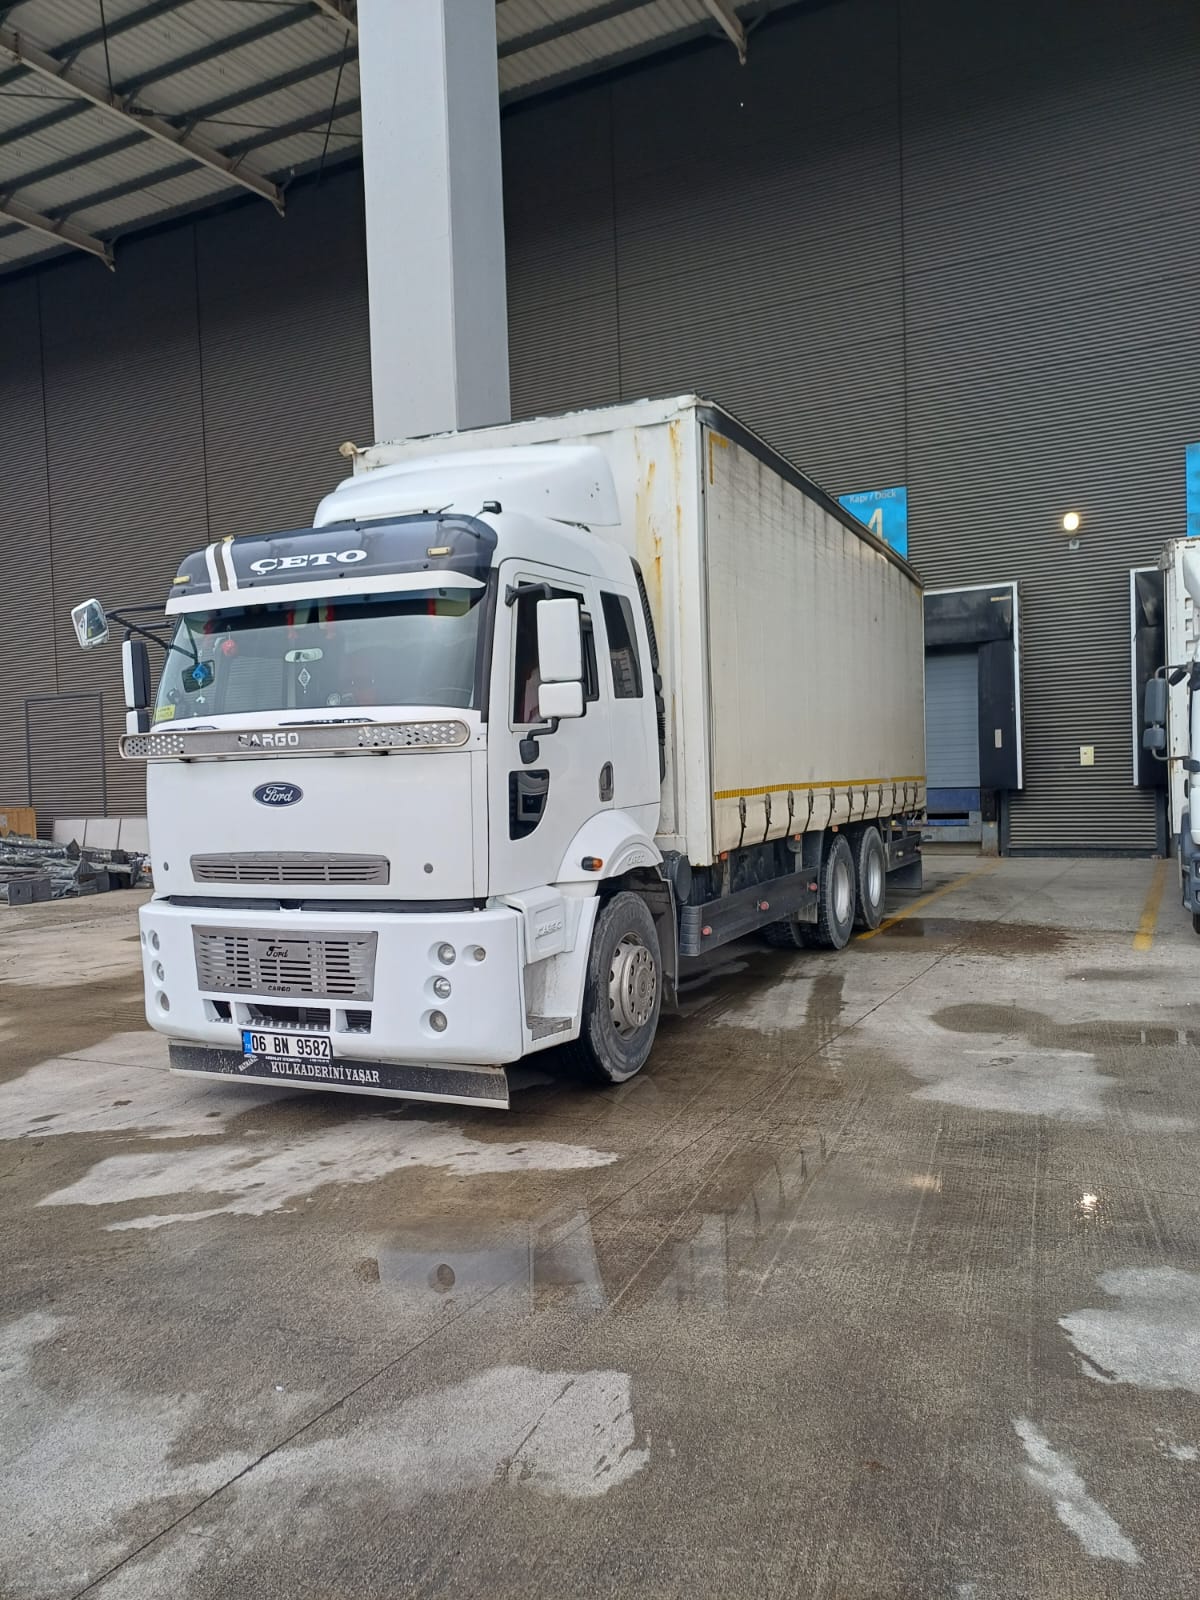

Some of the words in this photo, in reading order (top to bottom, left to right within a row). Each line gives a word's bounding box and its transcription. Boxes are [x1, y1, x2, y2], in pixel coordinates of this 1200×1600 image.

[874, 488, 896, 500] Dock
[867, 507, 888, 546] 4
[250, 549, 368, 576] ÇETO
[237, 732, 299, 748] CARGO
[262, 786, 294, 802] Ford
[266, 945, 289, 958] Ford
[251, 1034, 266, 1052] 06
[273, 1036, 289, 1055] BN
[296, 1038, 329, 1058] 9582
[271, 1060, 293, 1074] KUL
[293, 1063, 345, 1080] KADERİNİ
[345, 1068, 380, 1084] YAŞAR
